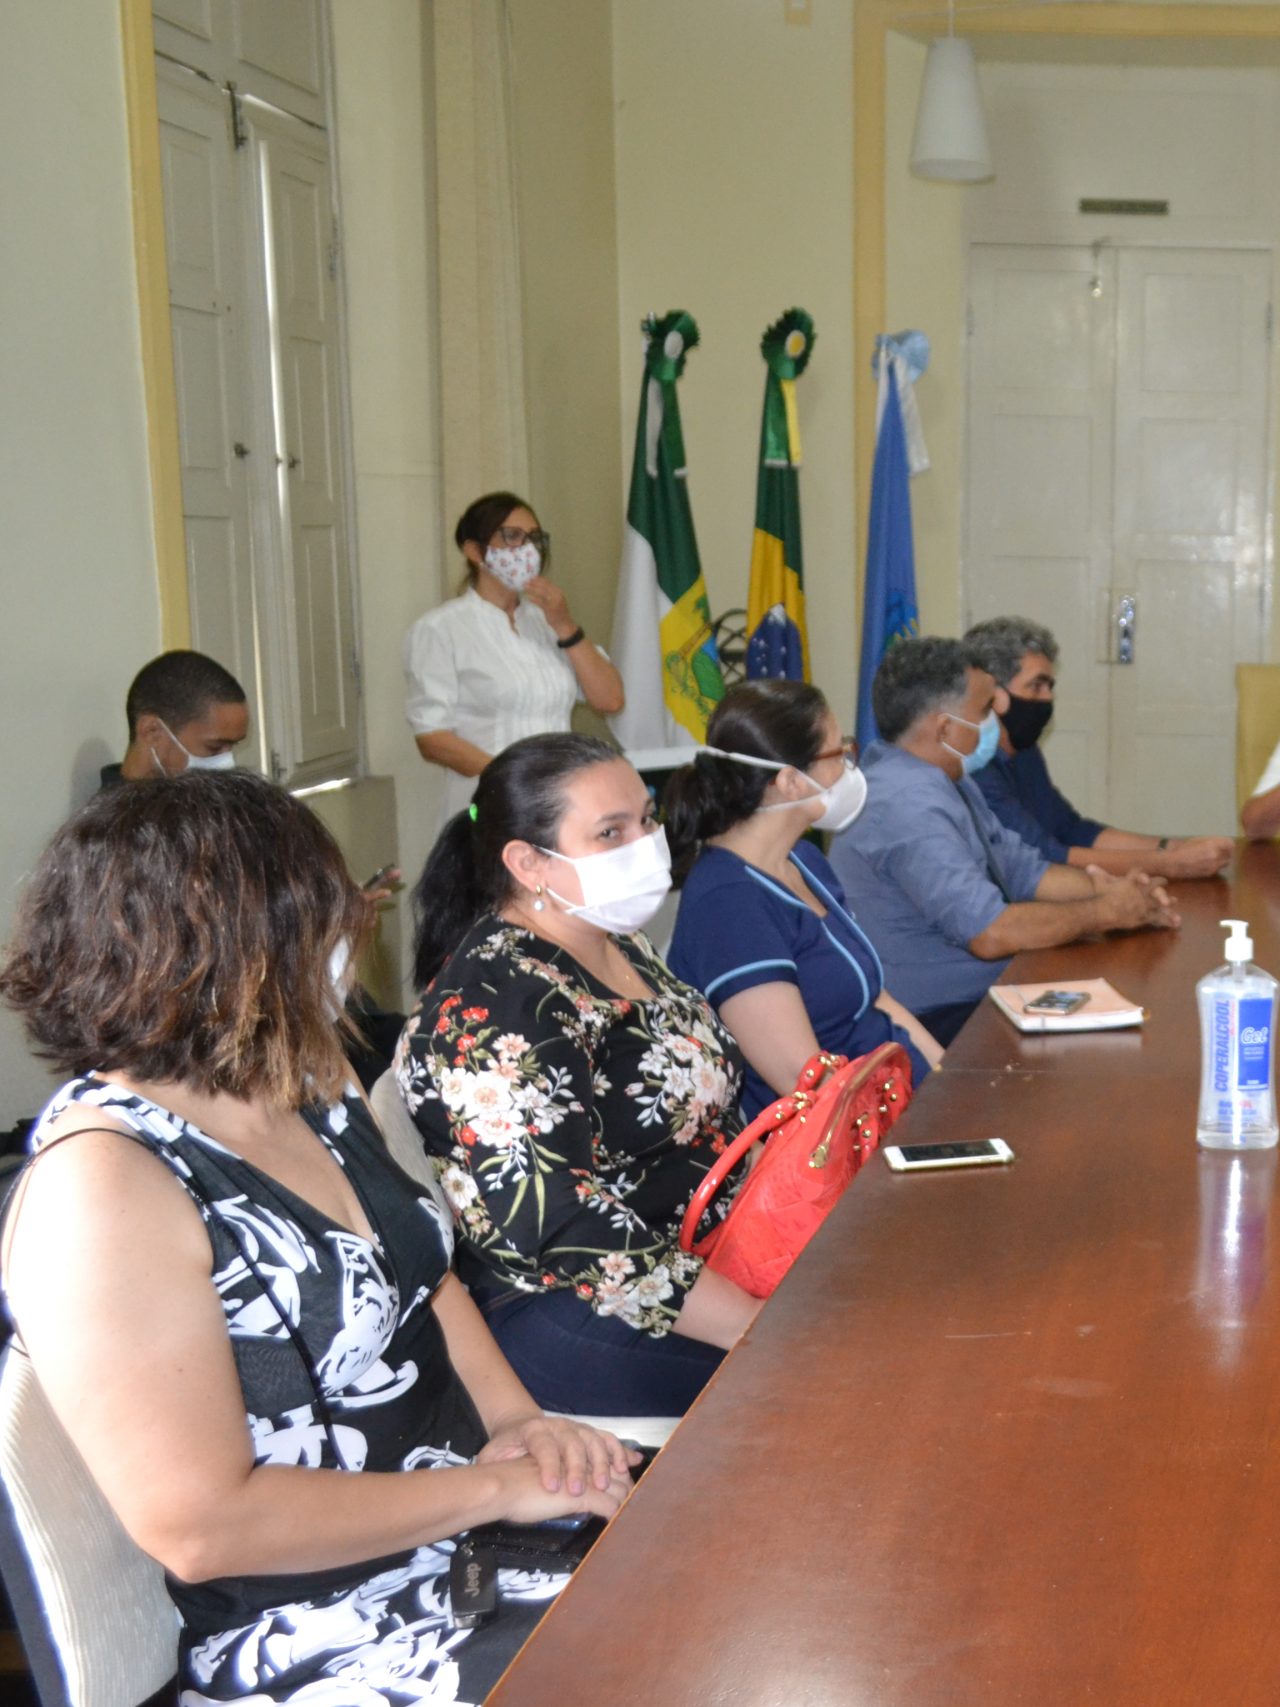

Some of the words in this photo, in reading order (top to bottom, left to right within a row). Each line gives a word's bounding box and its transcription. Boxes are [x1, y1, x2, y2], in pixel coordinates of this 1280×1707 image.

[1214, 999, 1230, 1093] COPERALCOOL
[1241, 1026, 1269, 1045] Gel
[464, 1563, 482, 1598] Jeep
